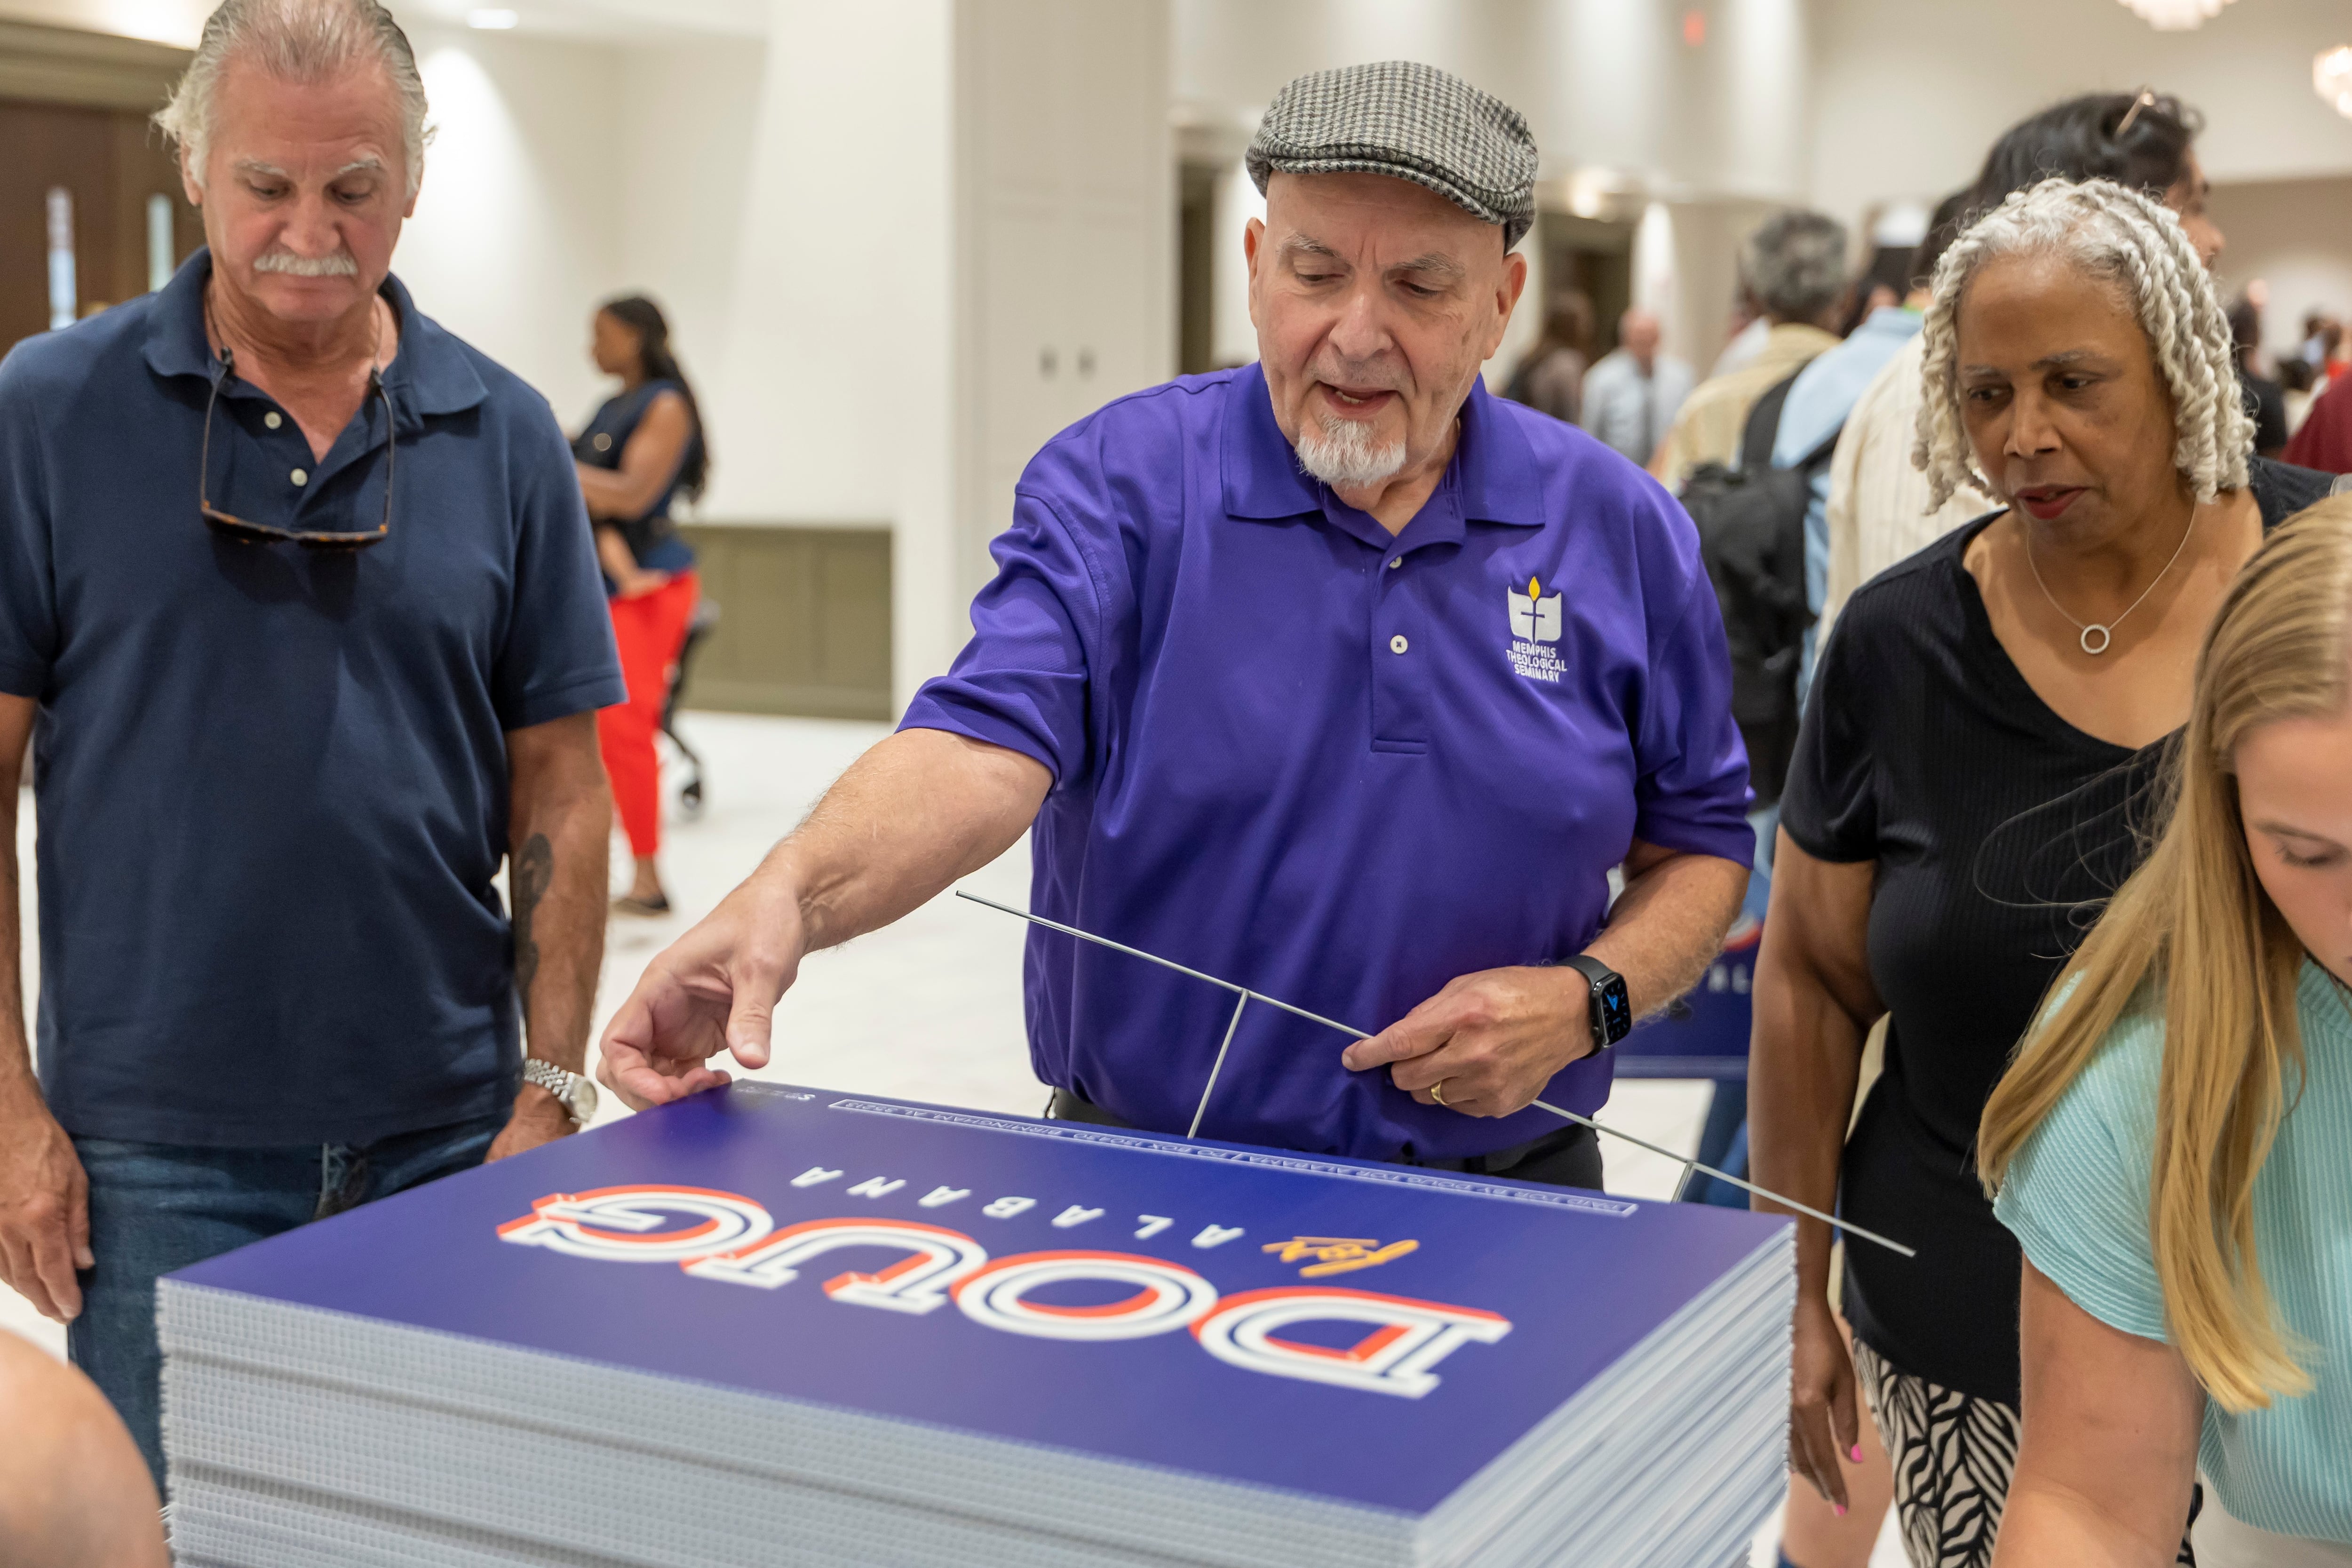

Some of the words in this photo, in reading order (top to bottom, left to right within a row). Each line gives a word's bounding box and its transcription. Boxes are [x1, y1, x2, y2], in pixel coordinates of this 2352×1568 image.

[1513, 641, 1556, 658] MEMPHIS
[1506, 650, 1567, 672] THEOLOGICAL
[1514, 664, 1559, 682] SEMINARY
[904, 1109, 926, 1118] AL
[1147, 1143, 1193, 1154] BOX
[1197, 1149, 1227, 1158] PO
[1249, 1155, 1354, 1175] ALABAMA
[1356, 1170, 1400, 1181] FOR
[1407, 1177, 1471, 1190] DOUG
[1477, 1187, 1507, 1195] BY
[1514, 1191, 1560, 1203] FOR
[789, 1166, 1244, 1248] ALABAMA
[1566, 1198, 1620, 1210] PAID
[497, 1184, 1512, 1398] DOUG
